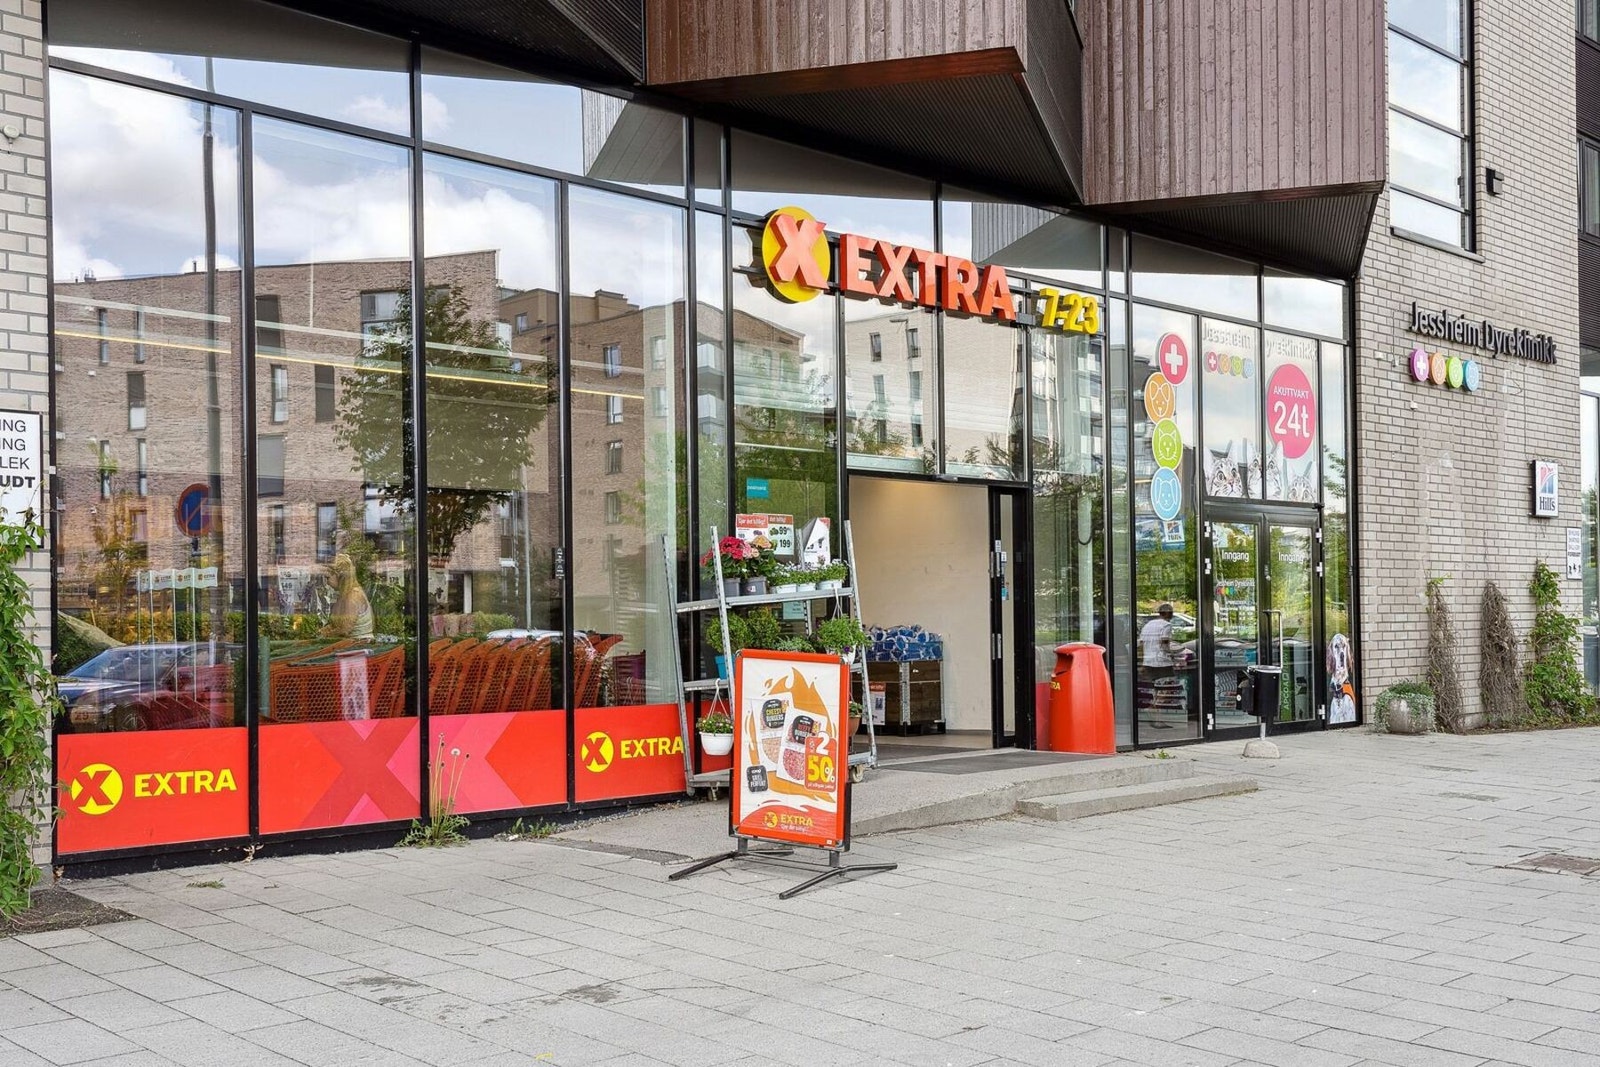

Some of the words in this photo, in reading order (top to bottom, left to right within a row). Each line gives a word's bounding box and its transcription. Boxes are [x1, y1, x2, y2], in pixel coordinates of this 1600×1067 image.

[840, 233, 1016, 321] EXTRA
[1039, 287, 1099, 335] 7-23
[1409, 301, 1482, 348] Jessheim
[1482, 320, 1558, 365] Dyreklinikk
[1273, 385, 1310, 399] AKUTTVAKT
[1273, 400, 1311, 438] 24t
[0, 475, 36, 488] UDT
[1221, 549, 1250, 562] Inngang
[1278, 551, 1304, 564] Inngang
[620, 736, 685, 759] EXTRA
[816, 731, 830, 755] 2
[807, 754, 836, 783] 50%
[134, 768, 238, 798] EXTRA
[780, 813, 814, 827] EXTRA
